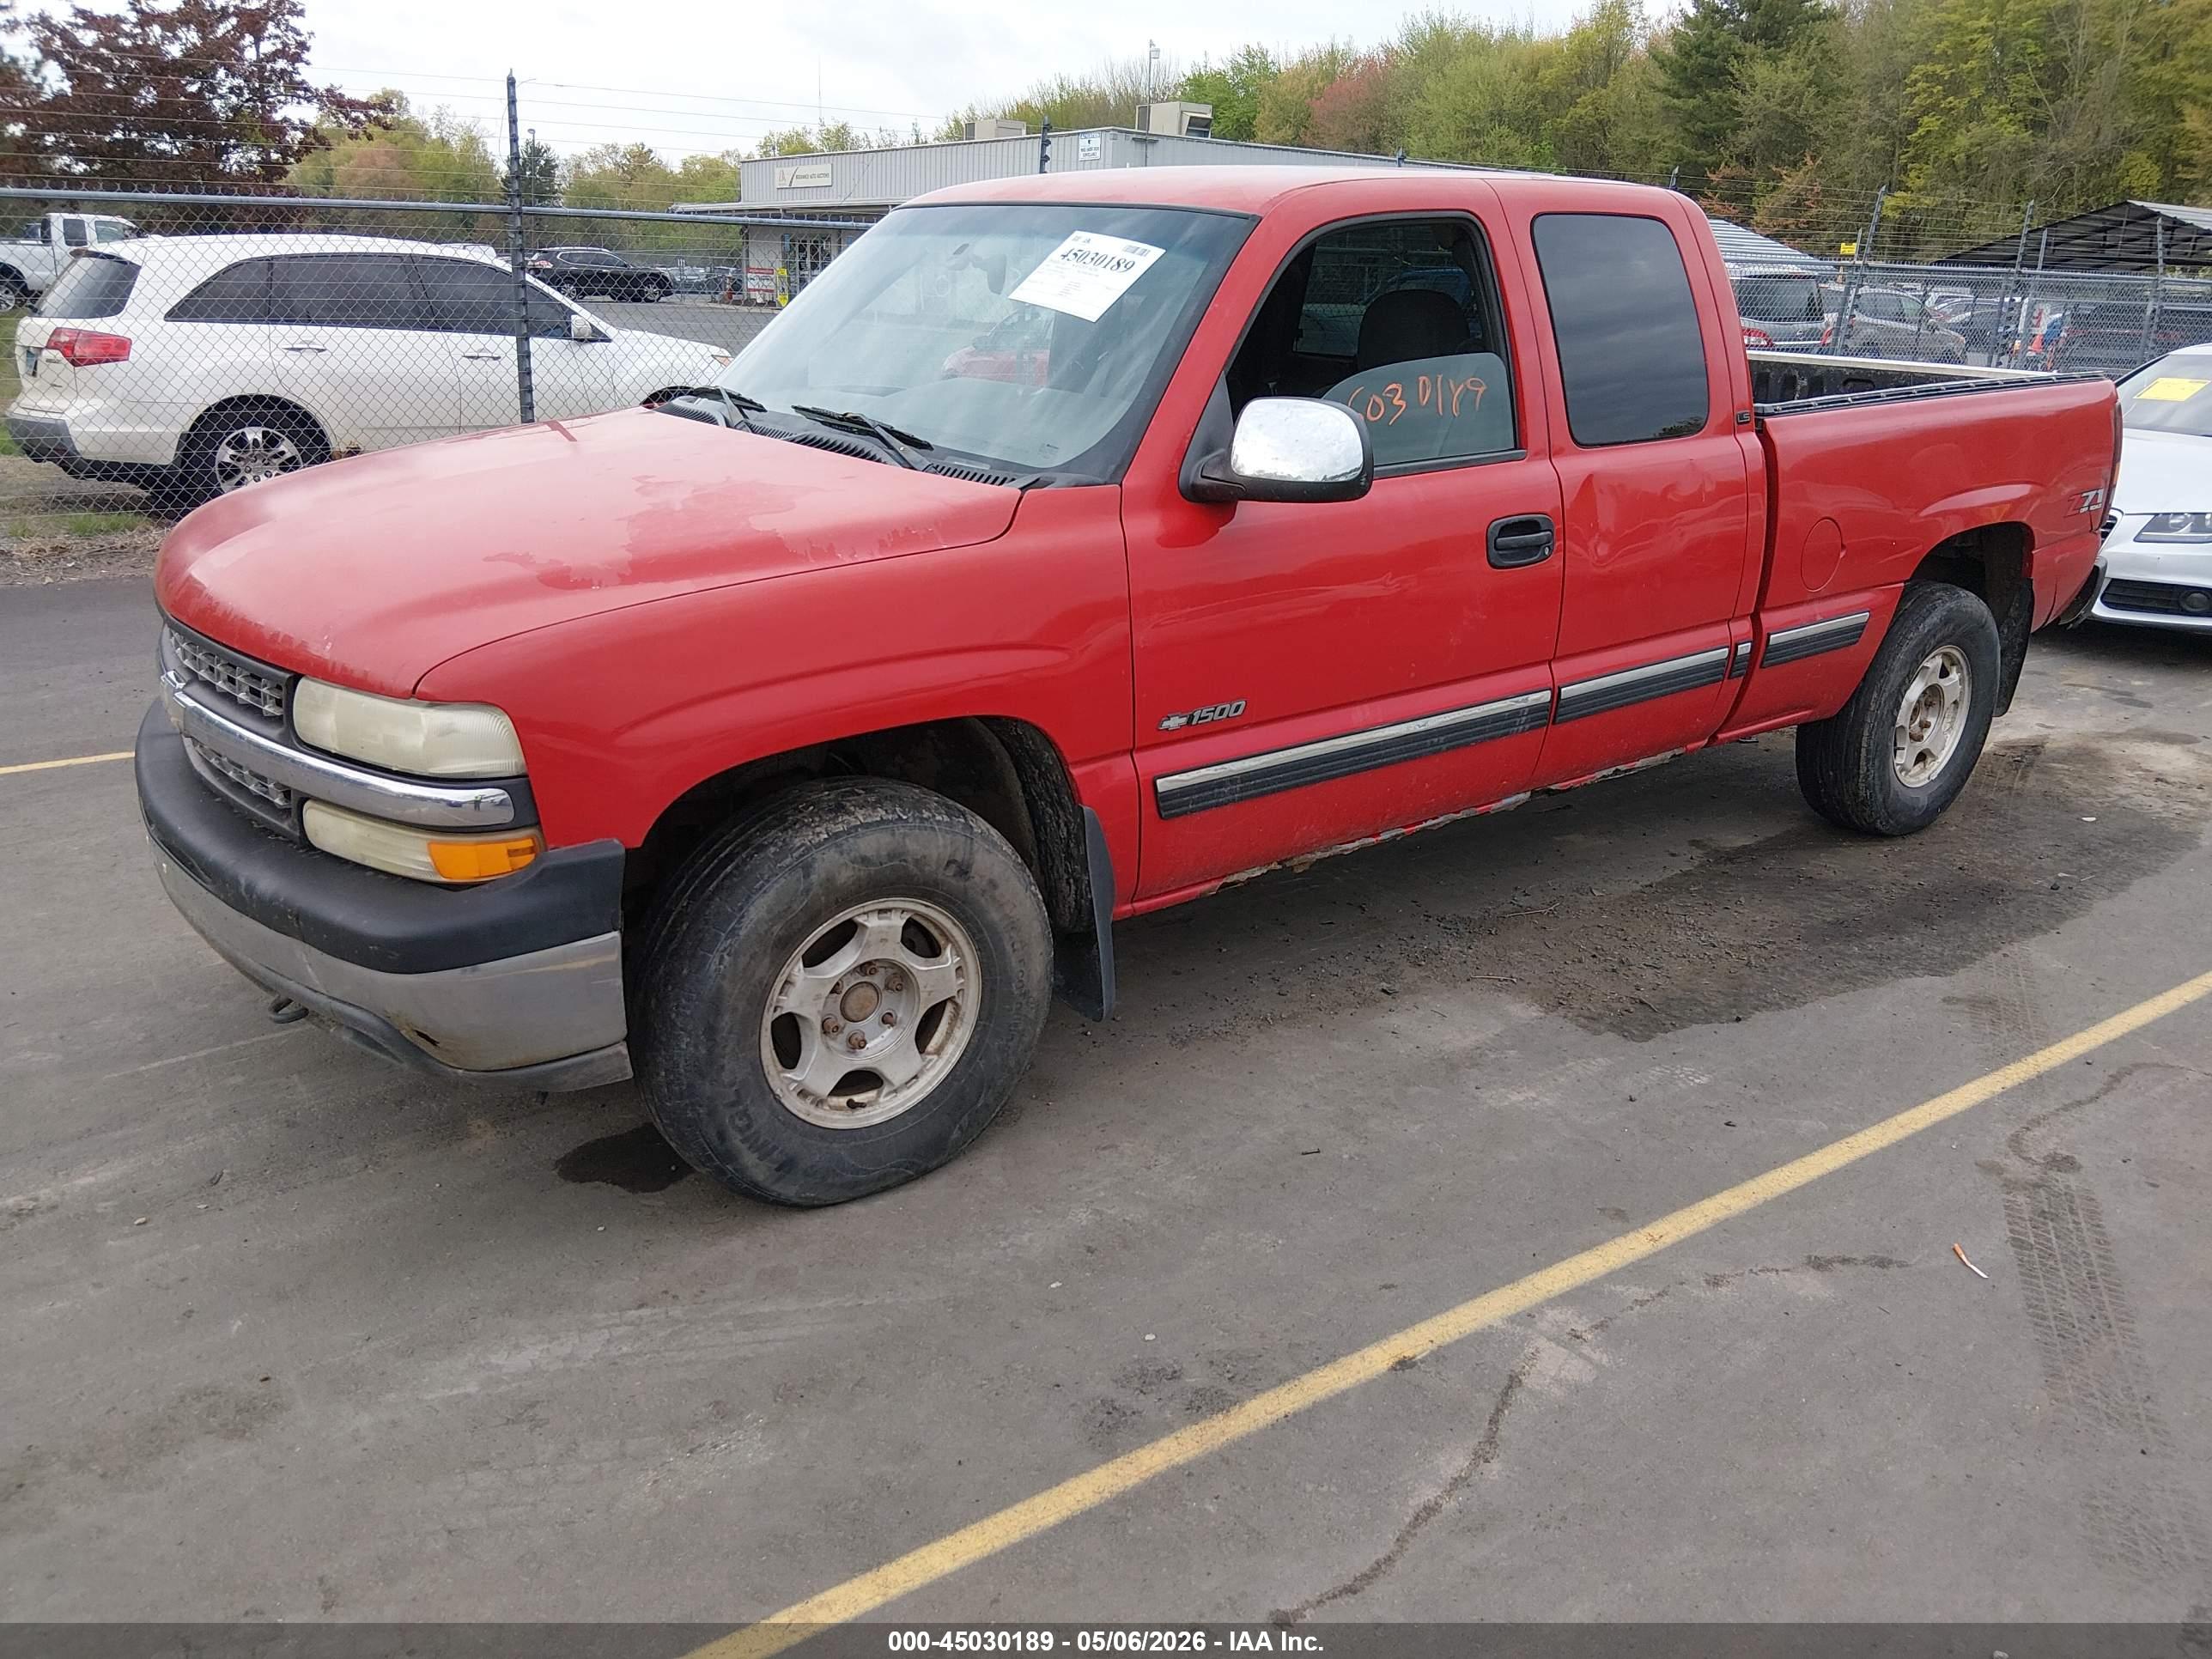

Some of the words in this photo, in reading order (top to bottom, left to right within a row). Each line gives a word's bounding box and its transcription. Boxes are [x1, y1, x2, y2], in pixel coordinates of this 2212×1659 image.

[1060, 248, 1136, 273] 45030189
[1737, 413, 1751, 422] LS
[2065, 489, 2104, 517] Z71
[1191, 701, 1246, 725] 1500
